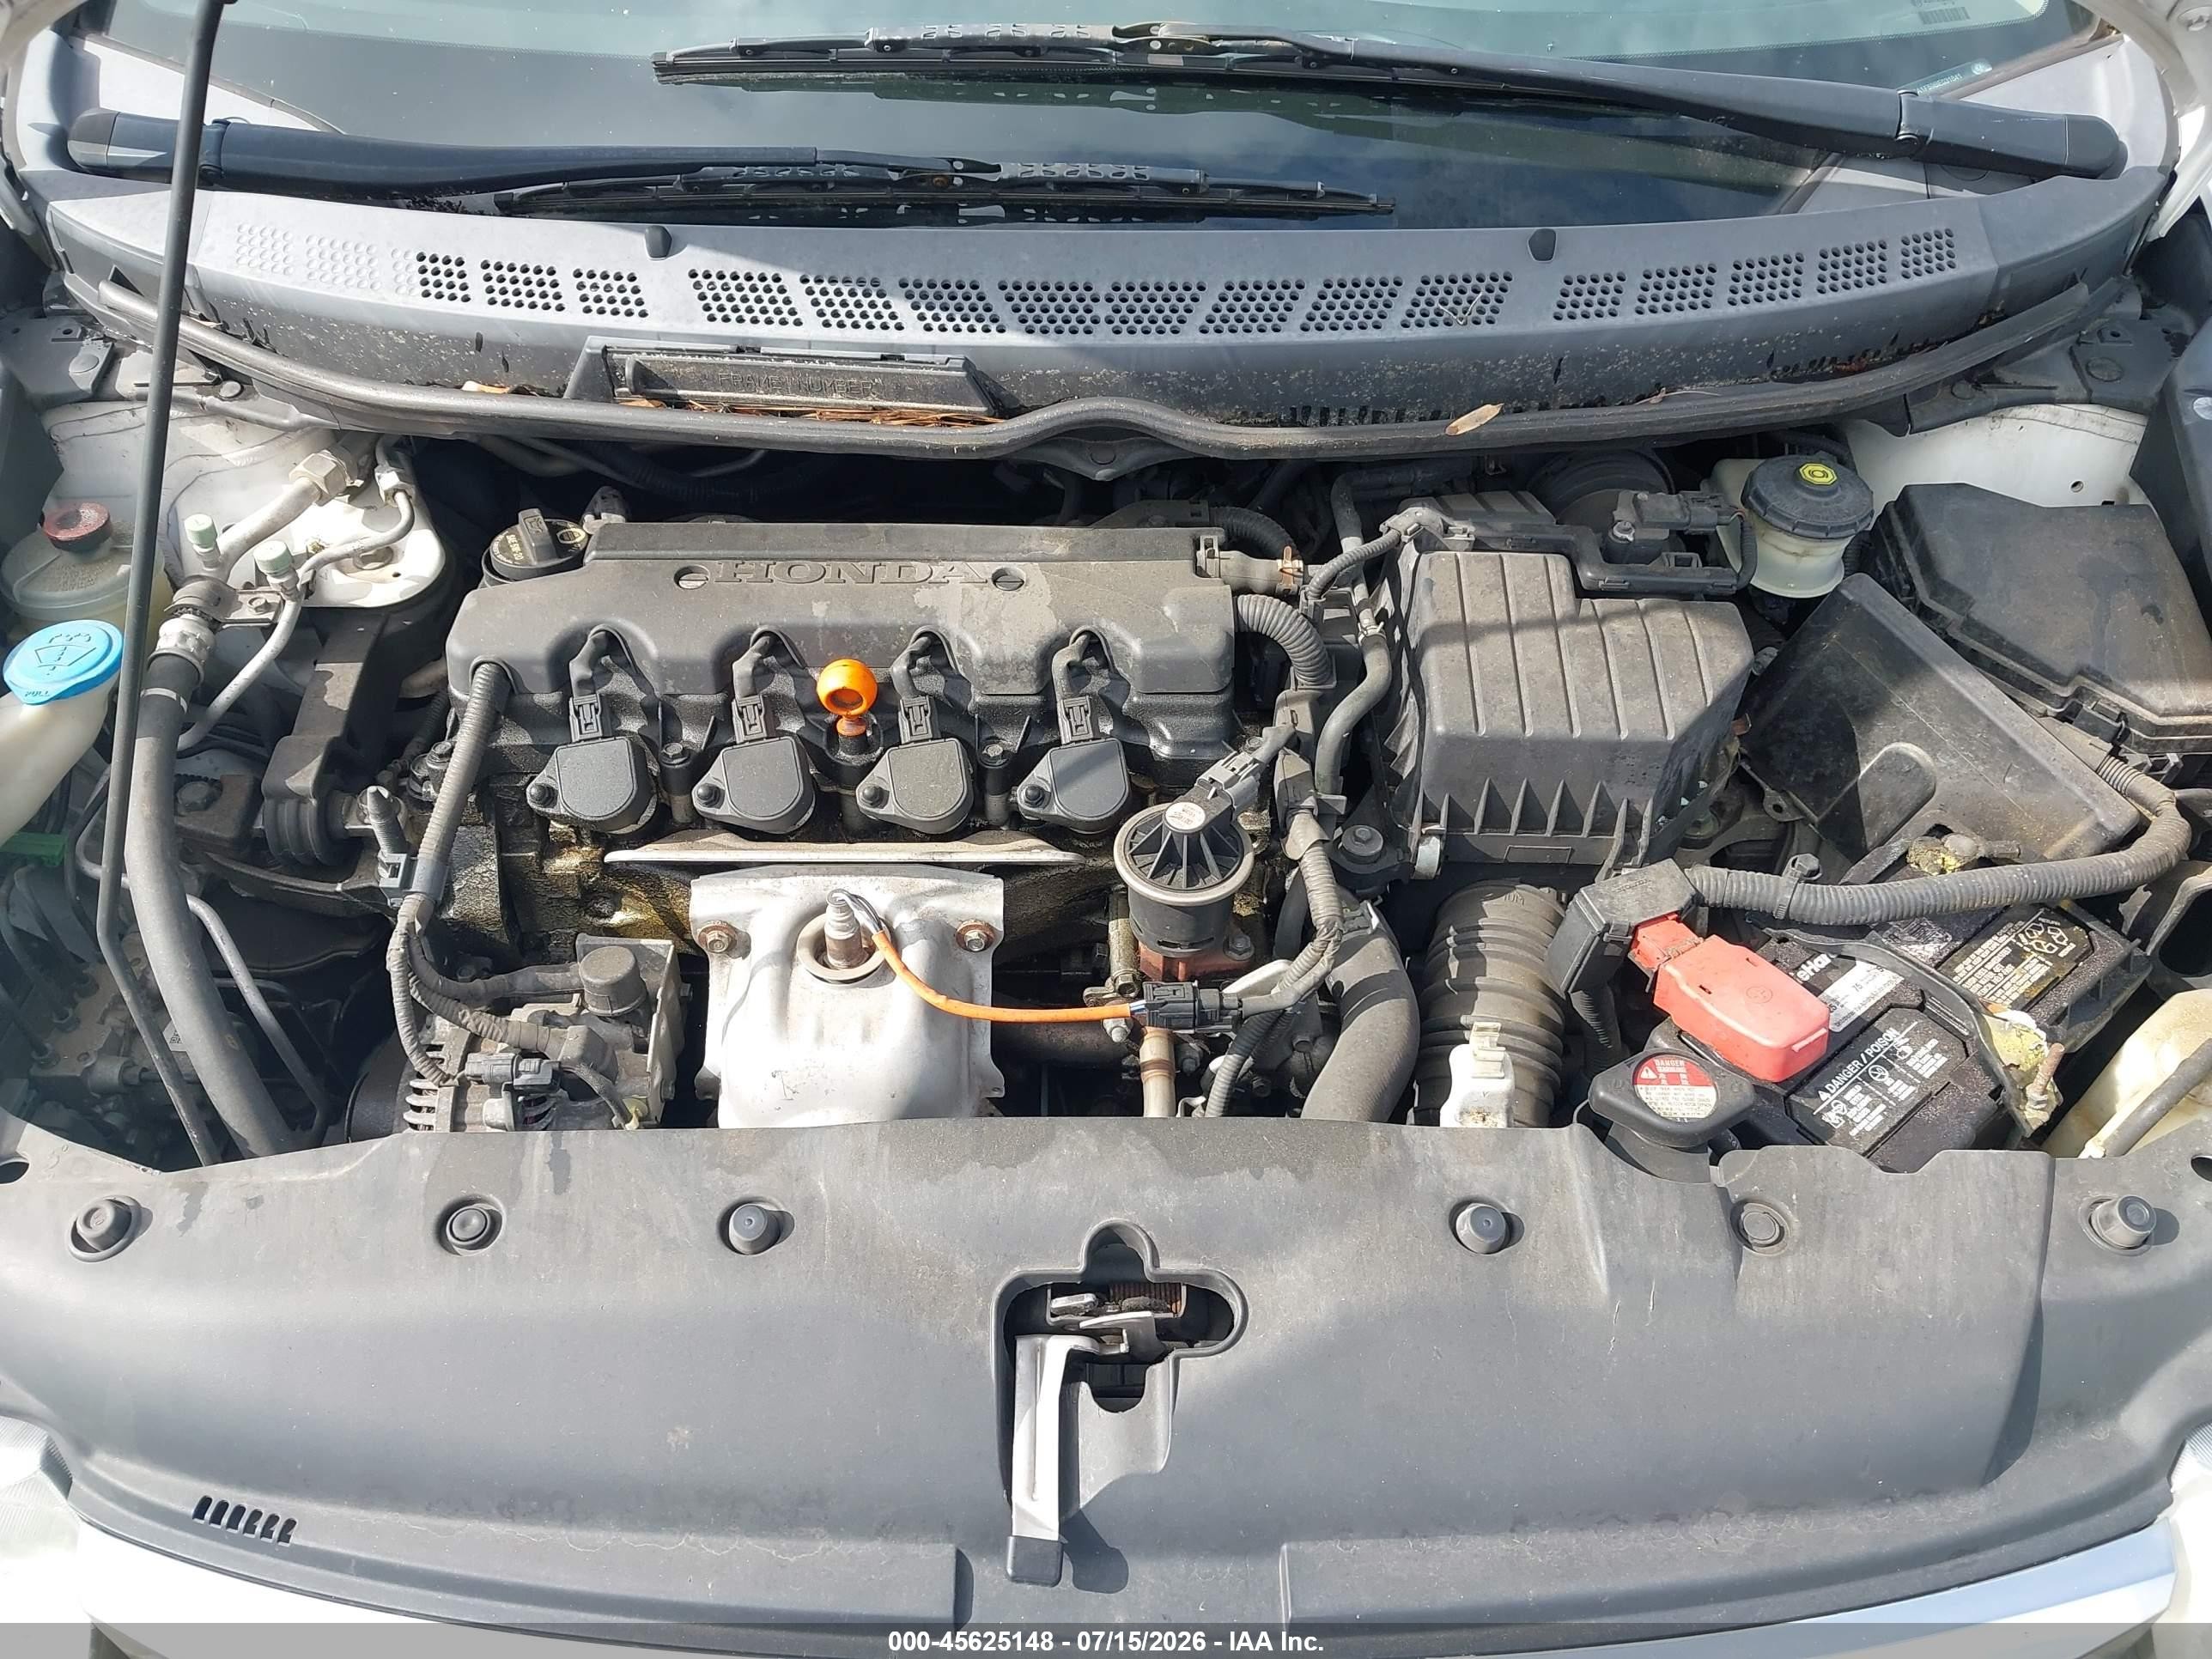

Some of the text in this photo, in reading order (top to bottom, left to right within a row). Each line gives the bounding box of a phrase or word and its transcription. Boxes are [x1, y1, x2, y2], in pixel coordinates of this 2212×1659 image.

[719, 371, 876, 398] FRAME NUMBER
[714, 561, 988, 585] HONDA
[1654, 1058, 1685, 1066] DANGER
[1825, 1059, 1863, 1092] DANGER
[1860, 1054, 1867, 1064] /
[1865, 1026, 1899, 1057] POISON
